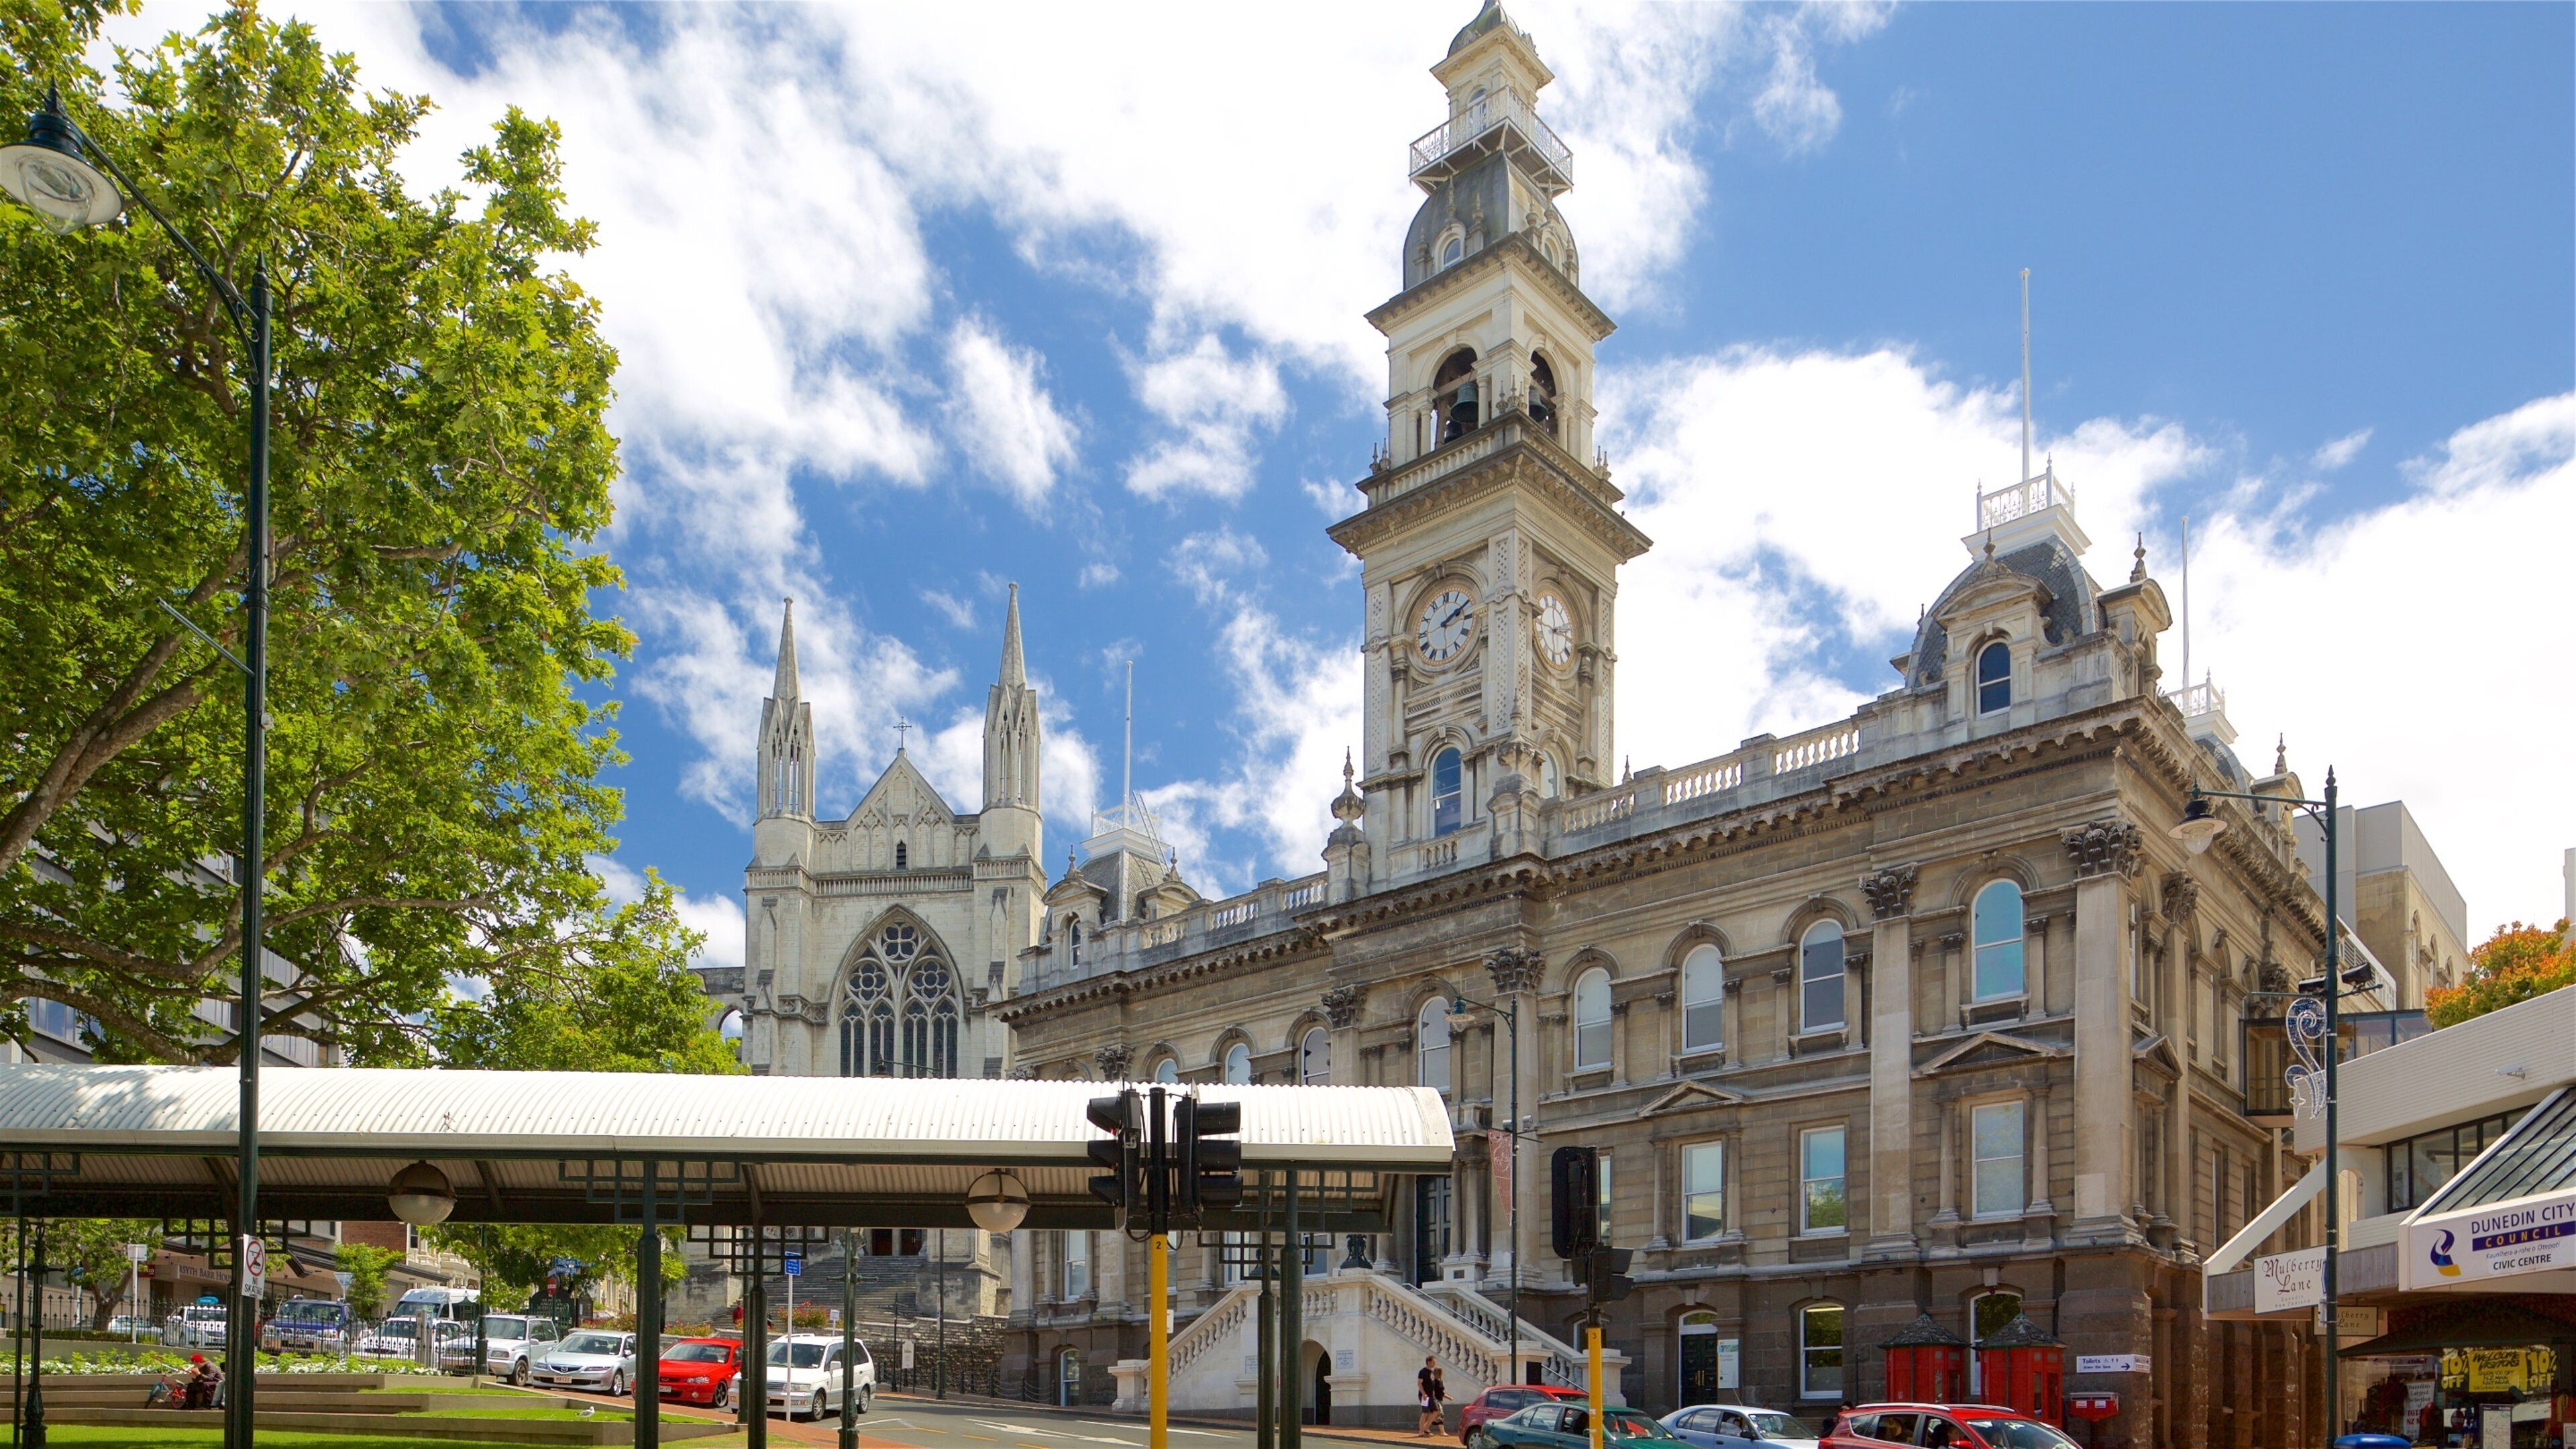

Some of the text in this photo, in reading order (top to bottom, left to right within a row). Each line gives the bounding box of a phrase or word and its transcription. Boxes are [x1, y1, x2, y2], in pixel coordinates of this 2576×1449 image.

[2471, 1202, 2575, 1234] DUNEDIN CITY
[2485, 1226, 2561, 1247] COUNCIL
[1156, 1241, 1161, 1249] 2
[2493, 1254, 2551, 1270] CIVIC CENTRE
[216, 1271, 231, 1282] HOUS
[2262, 1258, 2322, 1283] Mulberry
[252, 1277, 258, 1285] NO
[2277, 1275, 2312, 1295] Lane
[2337, 1310, 2369, 1320] ulberry
[2473, 1350, 2521, 1362] WELCOME
[2528, 1350, 2557, 1373] 10%
[2439, 1354, 2469, 1375] 10%
[2441, 1375, 2465, 1389] OFF
[2530, 1373, 2554, 1388] OFF
